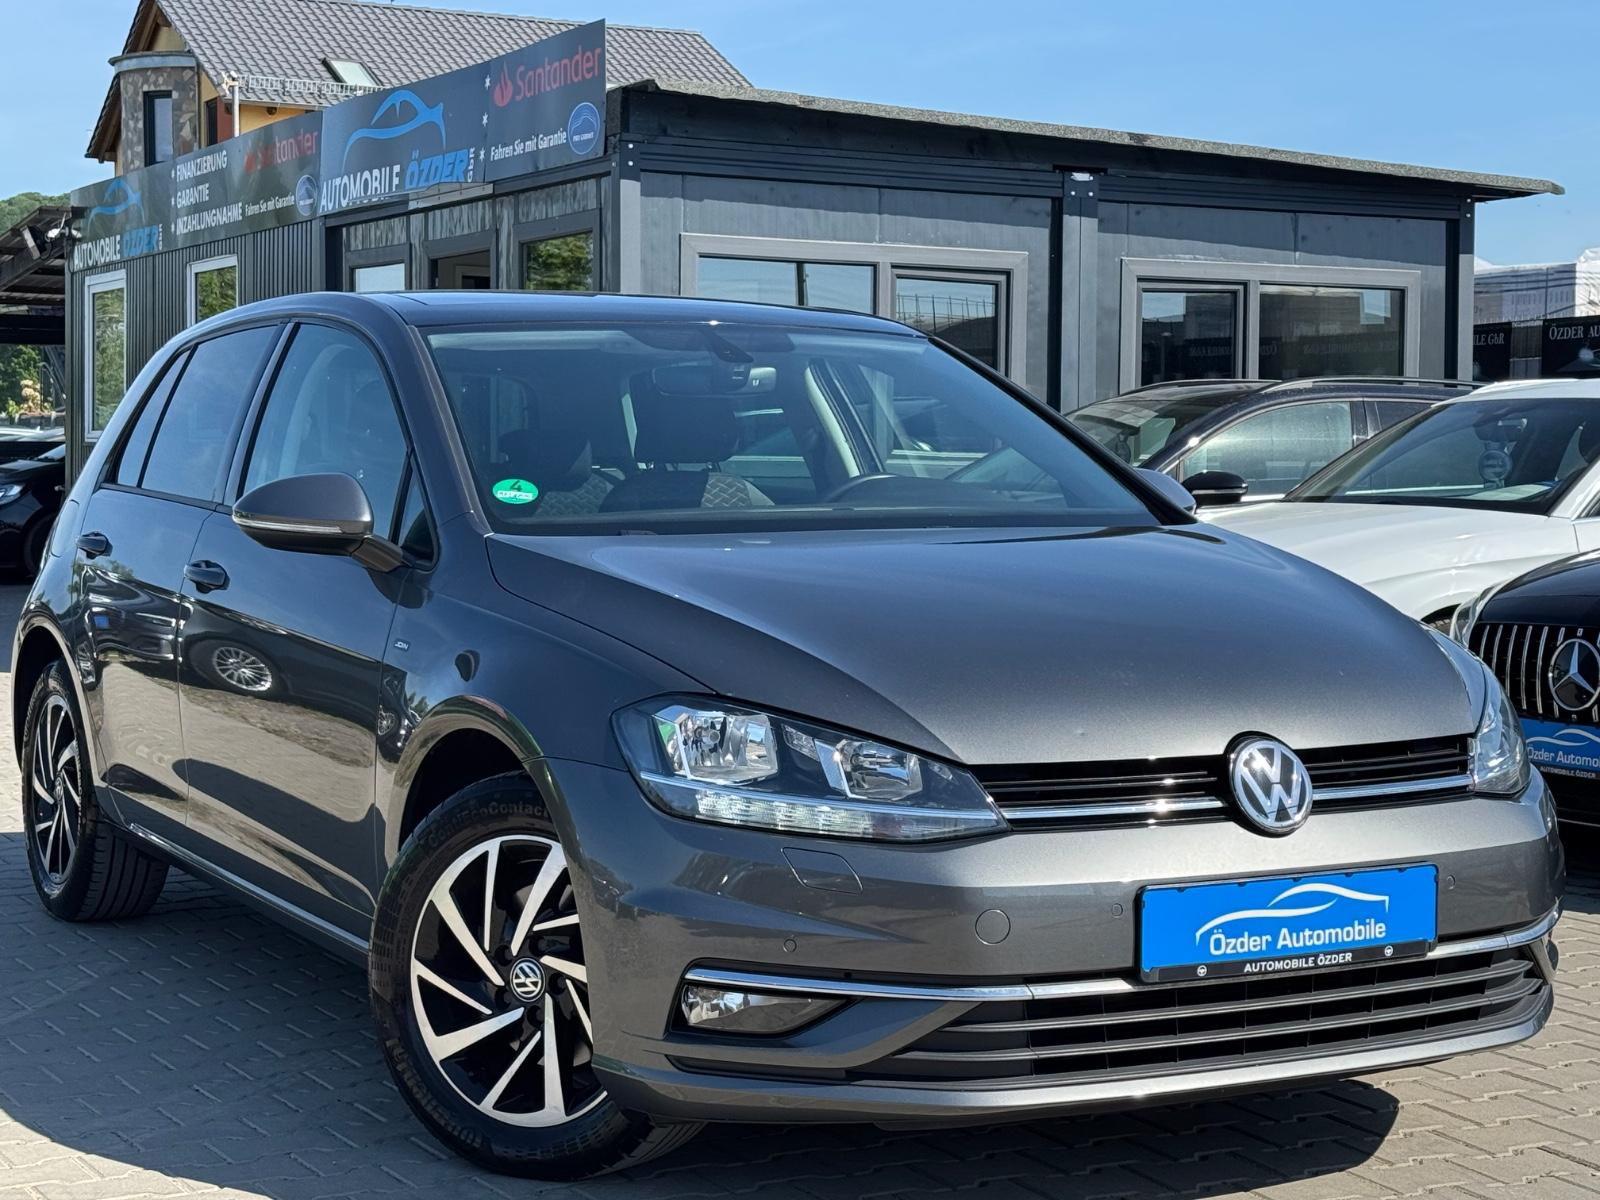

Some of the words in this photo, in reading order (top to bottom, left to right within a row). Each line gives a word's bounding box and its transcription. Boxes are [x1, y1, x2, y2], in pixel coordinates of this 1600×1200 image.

[515, 45, 602, 102] Santander
[490, 144, 513, 161] Fahren
[514, 139, 524, 155] Sie
[525, 136, 537, 152] mit
[538, 128, 567, 149] Garantie
[176, 150, 227, 182] FINANZIERUNG
[405, 149, 468, 191] ÖZDER
[176, 183, 210, 209] GARANTIE
[176, 202, 243, 236] INZAHLUNGNAHME
[74, 234, 120, 272] AUTOMOBILE
[1549, 324, 1584, 341] ÖZDER
[510, 480, 522, 491] 4
[1527, 744, 1555, 761] Özder
[1557, 751, 1600, 767] Automo
[1209, 929, 1271, 955] Özder
[1276, 918, 1386, 950] Automobile
[1243, 956, 1315, 973] AUTOMOBILE
[1317, 952, 1352, 968] ÖZDER
